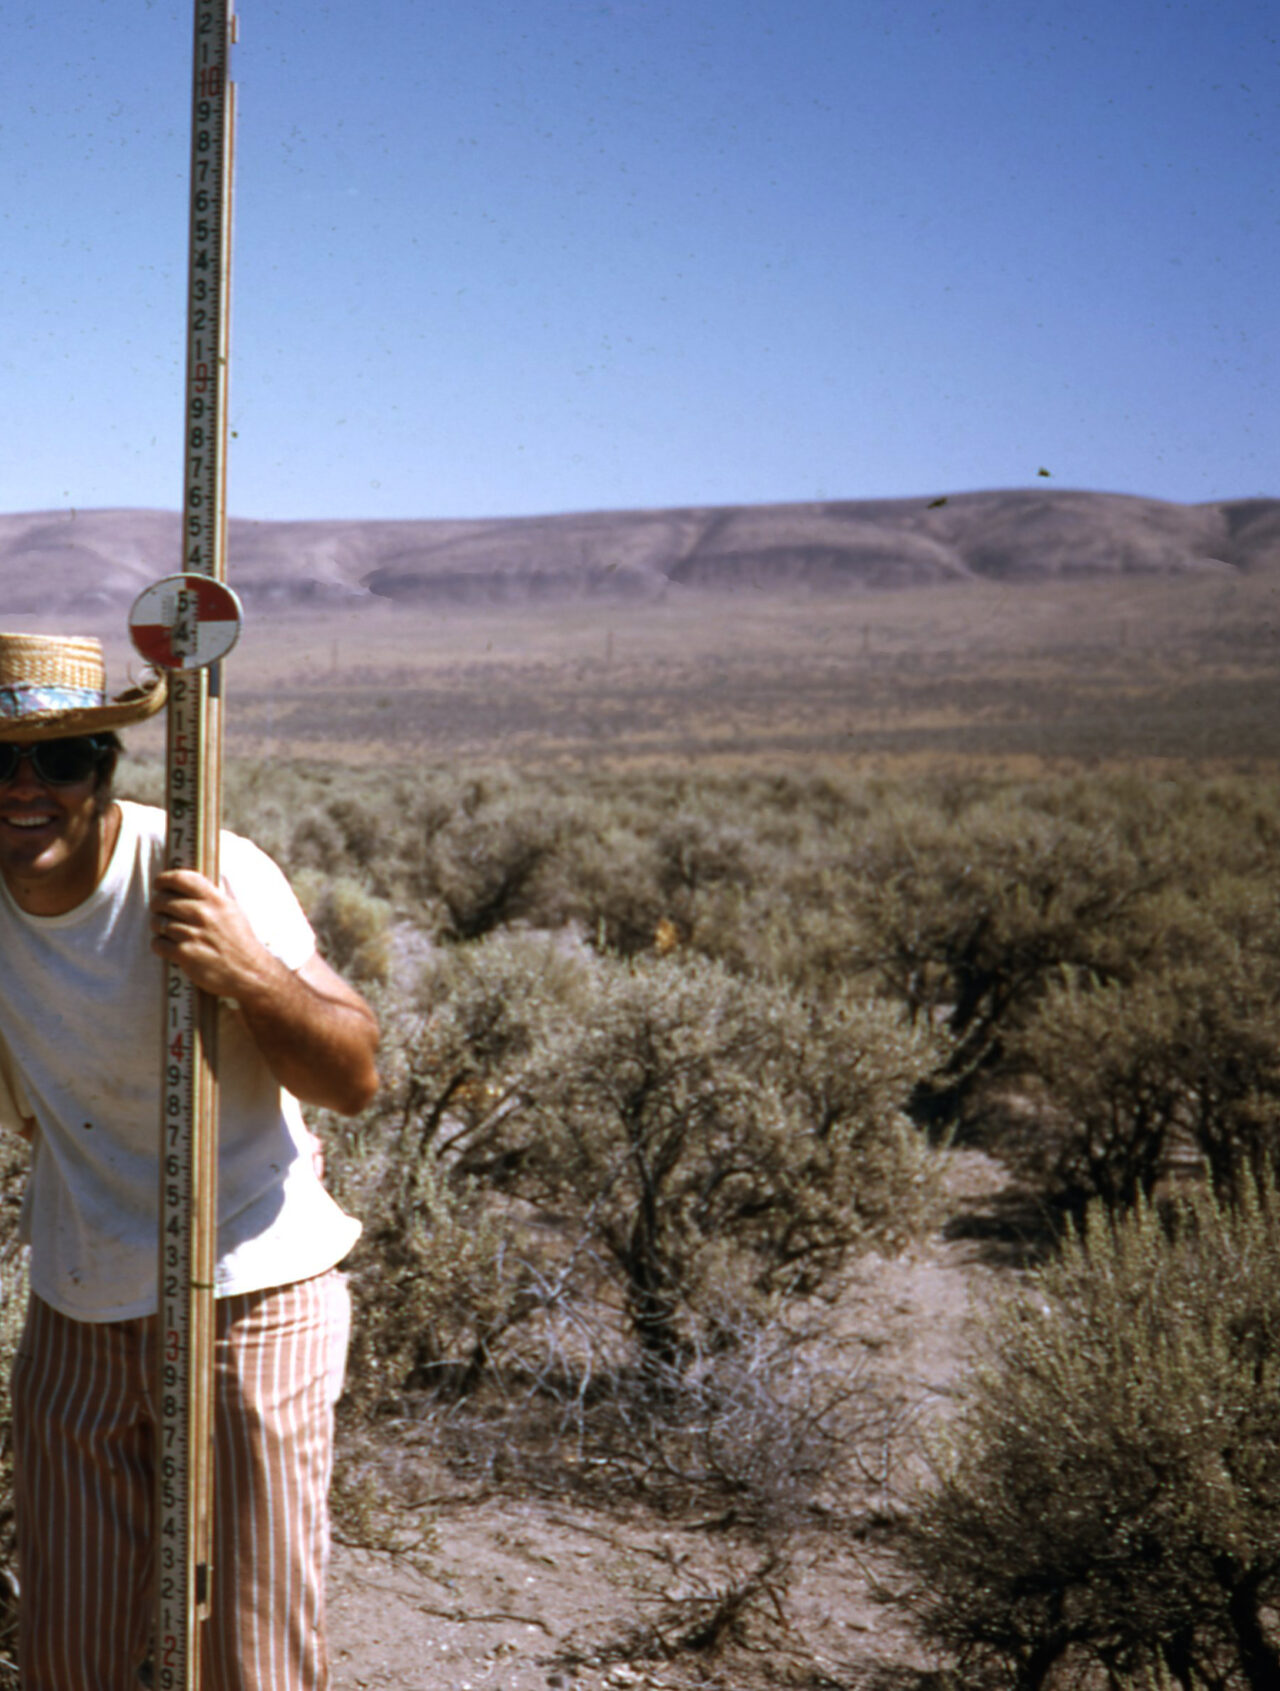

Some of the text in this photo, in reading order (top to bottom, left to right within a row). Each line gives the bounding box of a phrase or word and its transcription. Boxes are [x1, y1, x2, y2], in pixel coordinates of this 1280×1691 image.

[200, 12, 212, 34] 2
[202, 42, 208, 64] 1
[200, 66, 220, 98] 10
[198, 101, 210, 122] 9
[198, 130, 210, 152] 8
[197, 161, 209, 182] 7
[196, 189, 209, 211] 6
[196, 219, 209, 242] 5
[194, 249, 208, 270] 4
[195, 279, 206, 301] 3
[193, 309, 206, 331] 2
[196, 338, 202, 360] 1
[192, 397, 204, 419] 9
[190, 426, 204, 448] 8
[191, 456, 203, 478] 7
[190, 486, 202, 508] 6
[189, 516, 201, 537] 5
[188, 545, 201, 565] 4
[178, 590, 189, 612] 5
[174, 621, 189, 641] 4
[175, 680, 187, 701] 2
[177, 710, 183, 731] 1
[175, 735, 188, 766] 5
[172, 768, 185, 790] 9
[173, 828, 184, 849] 7
[168, 977, 181, 998] 2
[172, 1006, 177, 1028] 1
[170, 1031, 184, 1062] 4
[167, 1066, 180, 1086] 9
[167, 1095, 180, 1117] 8
[168, 1124, 179, 1147] 7
[166, 1154, 179, 1177] 6
[167, 1185, 179, 1207] 5
[167, 1216, 179, 1237] 4
[167, 1245, 178, 1267] 3
[165, 1276, 178, 1297] 2
[168, 1305, 174, 1327] 1
[166, 1330, 179, 1361] 3
[164, 1365, 176, 1387] 9
[163, 1395, 176, 1418] 8
[164, 1426, 176, 1447] 7
[162, 1456, 175, 1478] 6
[163, 1486, 175, 1508] 5
[163, 1517, 175, 1538] 4
[163, 1547, 174, 1569] 3
[161, 1578, 174, 1599] 2
[165, 1608, 171, 1630] 1
[163, 1635, 176, 1667] 2
[161, 1668, 174, 1690] 9
